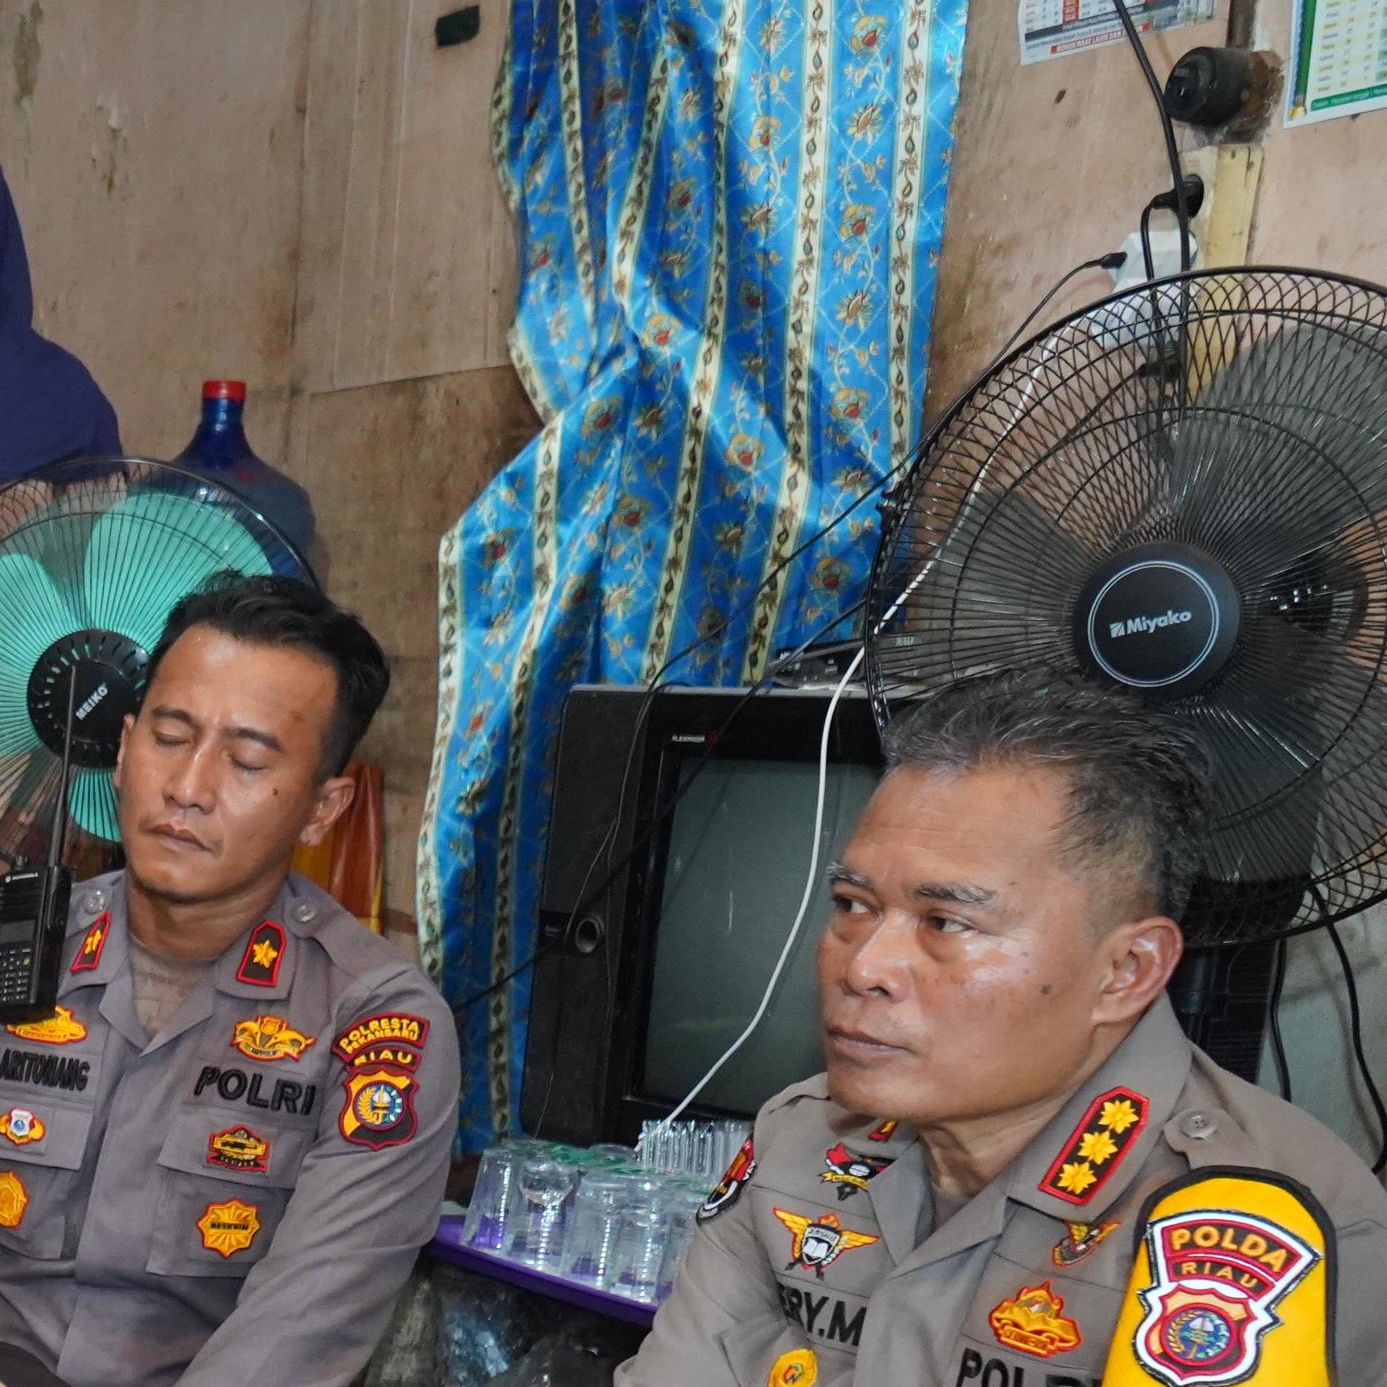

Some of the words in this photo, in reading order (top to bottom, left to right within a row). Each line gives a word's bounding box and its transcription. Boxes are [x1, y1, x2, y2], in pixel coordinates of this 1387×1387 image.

[1127, 609, 1192, 635] Miyako
[75, 686, 108, 720] MEIKO
[339, 1017, 420, 1050] POLRESTA
[344, 1028, 418, 1055] PEKANBARU
[354, 1049, 412, 1066] RIAU
[193, 1066, 317, 1116] POLRI
[1169, 1225, 1288, 1272] POLDA
[1181, 1261, 1258, 1289] RIAU
